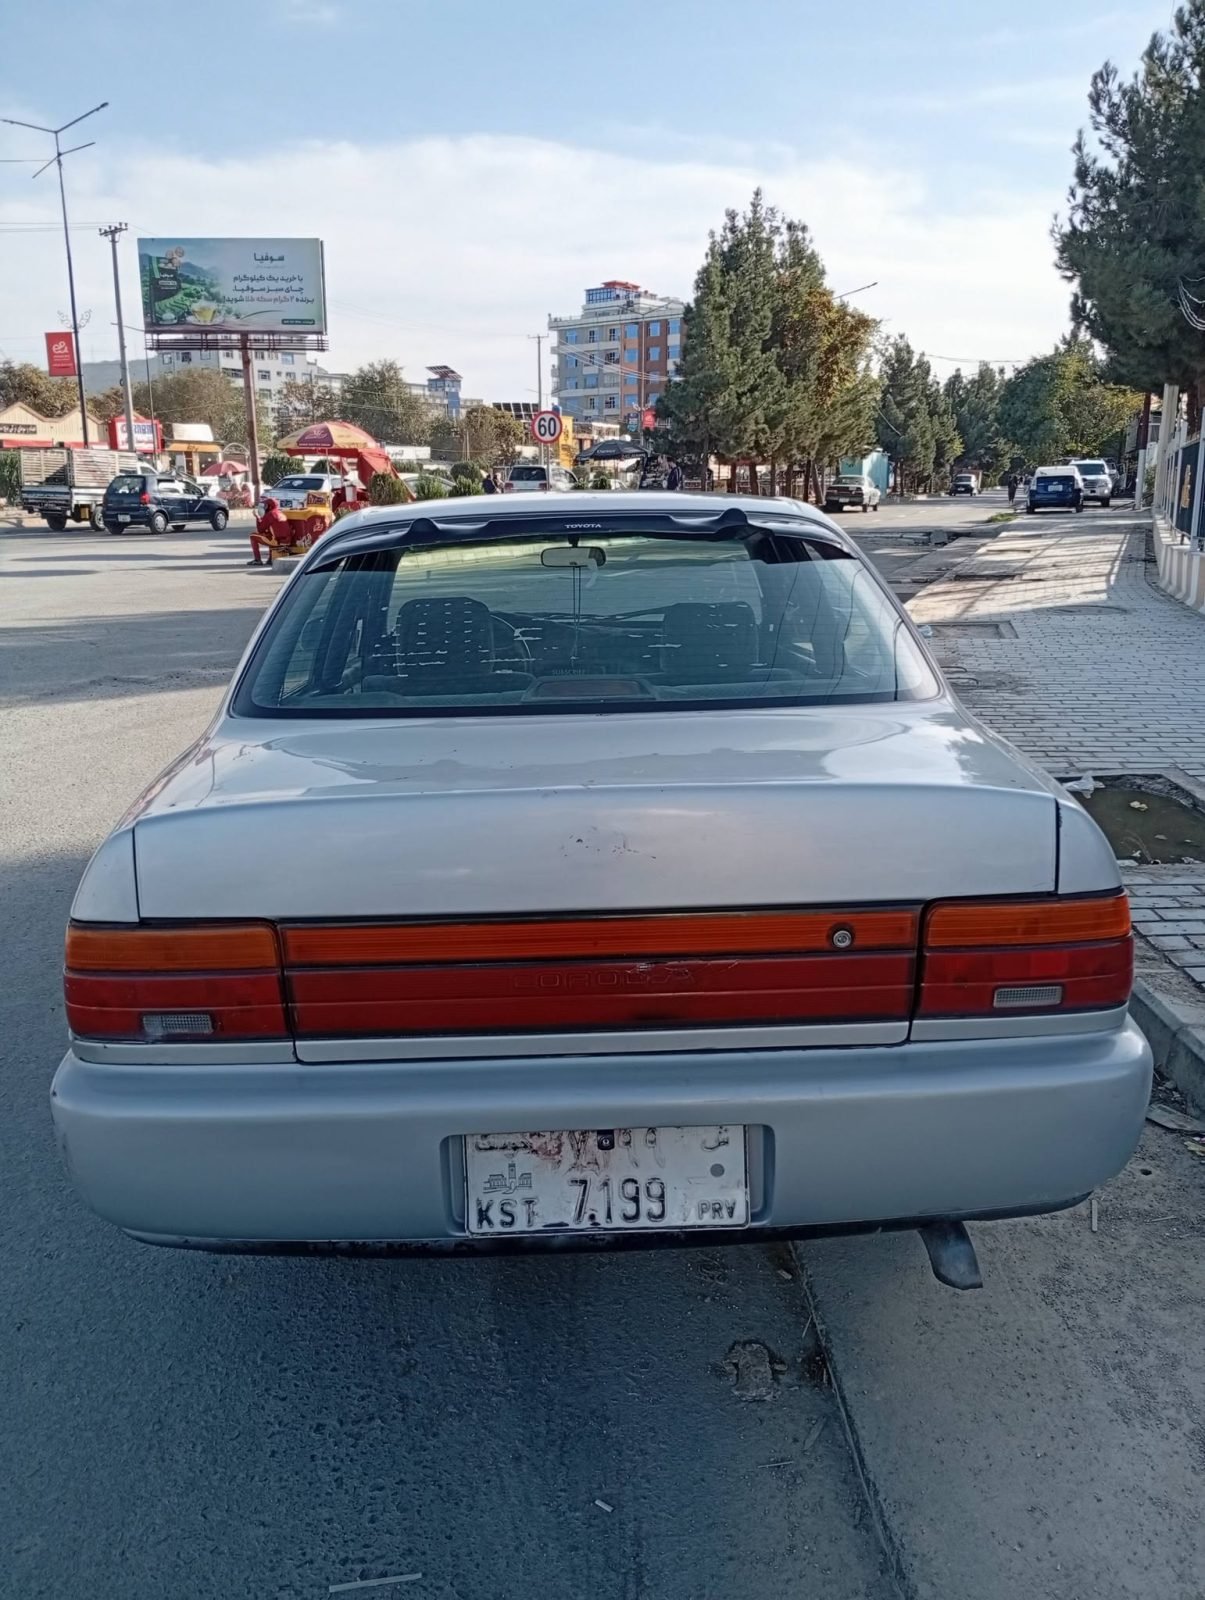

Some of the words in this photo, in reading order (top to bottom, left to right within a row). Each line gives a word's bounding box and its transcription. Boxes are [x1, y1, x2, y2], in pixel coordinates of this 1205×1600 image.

[253, 252, 285, 263] سوفیا
[233, 274, 266, 283] کیلوگرام
[280, 274, 297, 283] خرید
[538, 417, 556, 437] 60
[476, 1197, 537, 1229] KST
[568, 1176, 667, 1225] 7199
[698, 1199, 737, 1221] PRV
